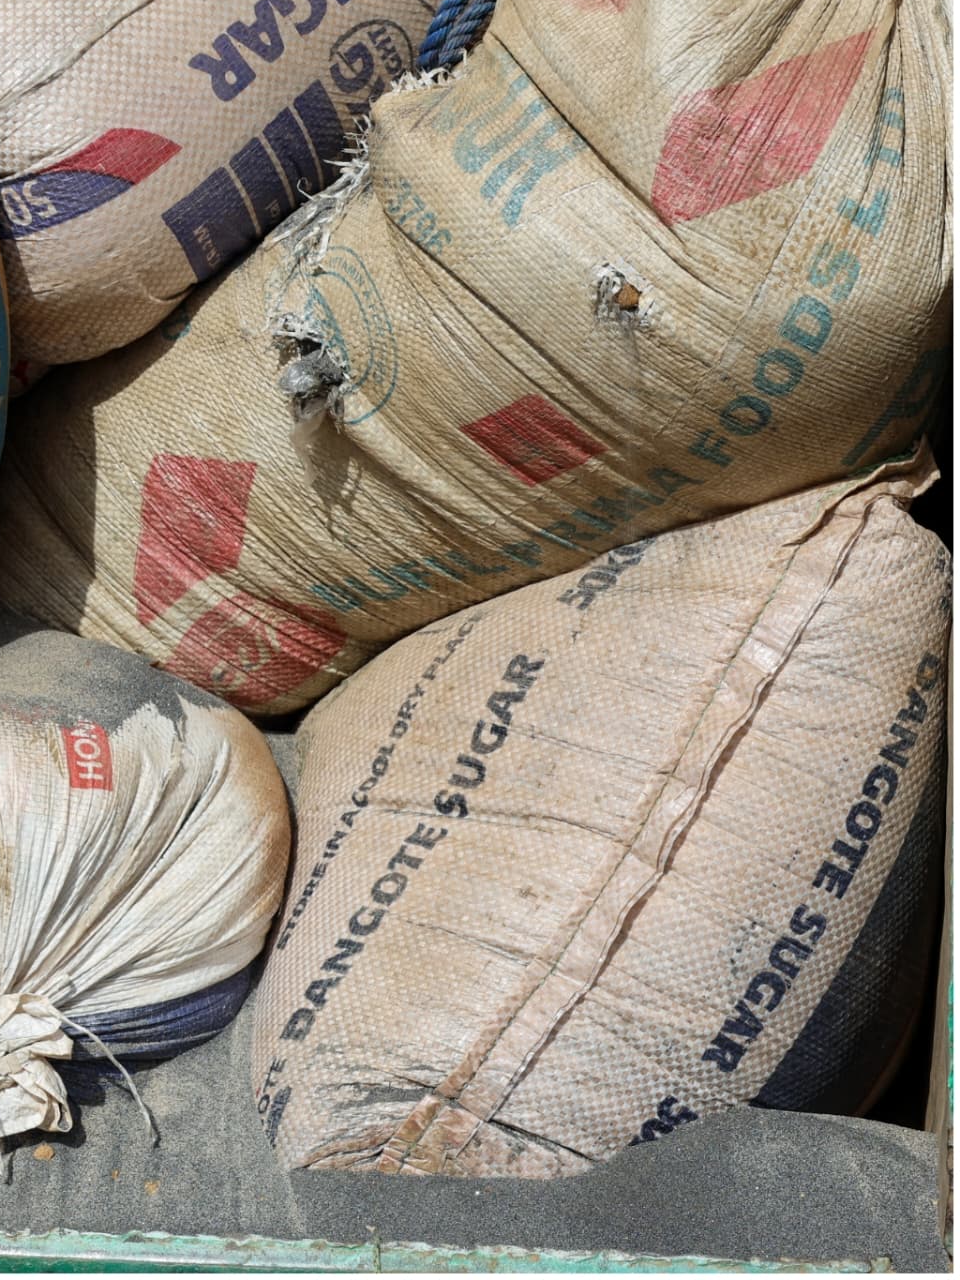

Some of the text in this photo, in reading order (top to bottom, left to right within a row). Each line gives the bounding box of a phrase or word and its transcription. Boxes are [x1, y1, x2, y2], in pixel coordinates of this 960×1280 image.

[688, 240, 863, 468] FOODS
[277, 862, 328, 951] STORE
[340, 807, 362, 829] A
[351, 741, 397, 810] COOL
[390, 682, 426, 740] DRY
[280, 652, 545, 1041] DANGOTE SUGAR
[702, 651, 941, 1072] DANGOTE SUGAR
